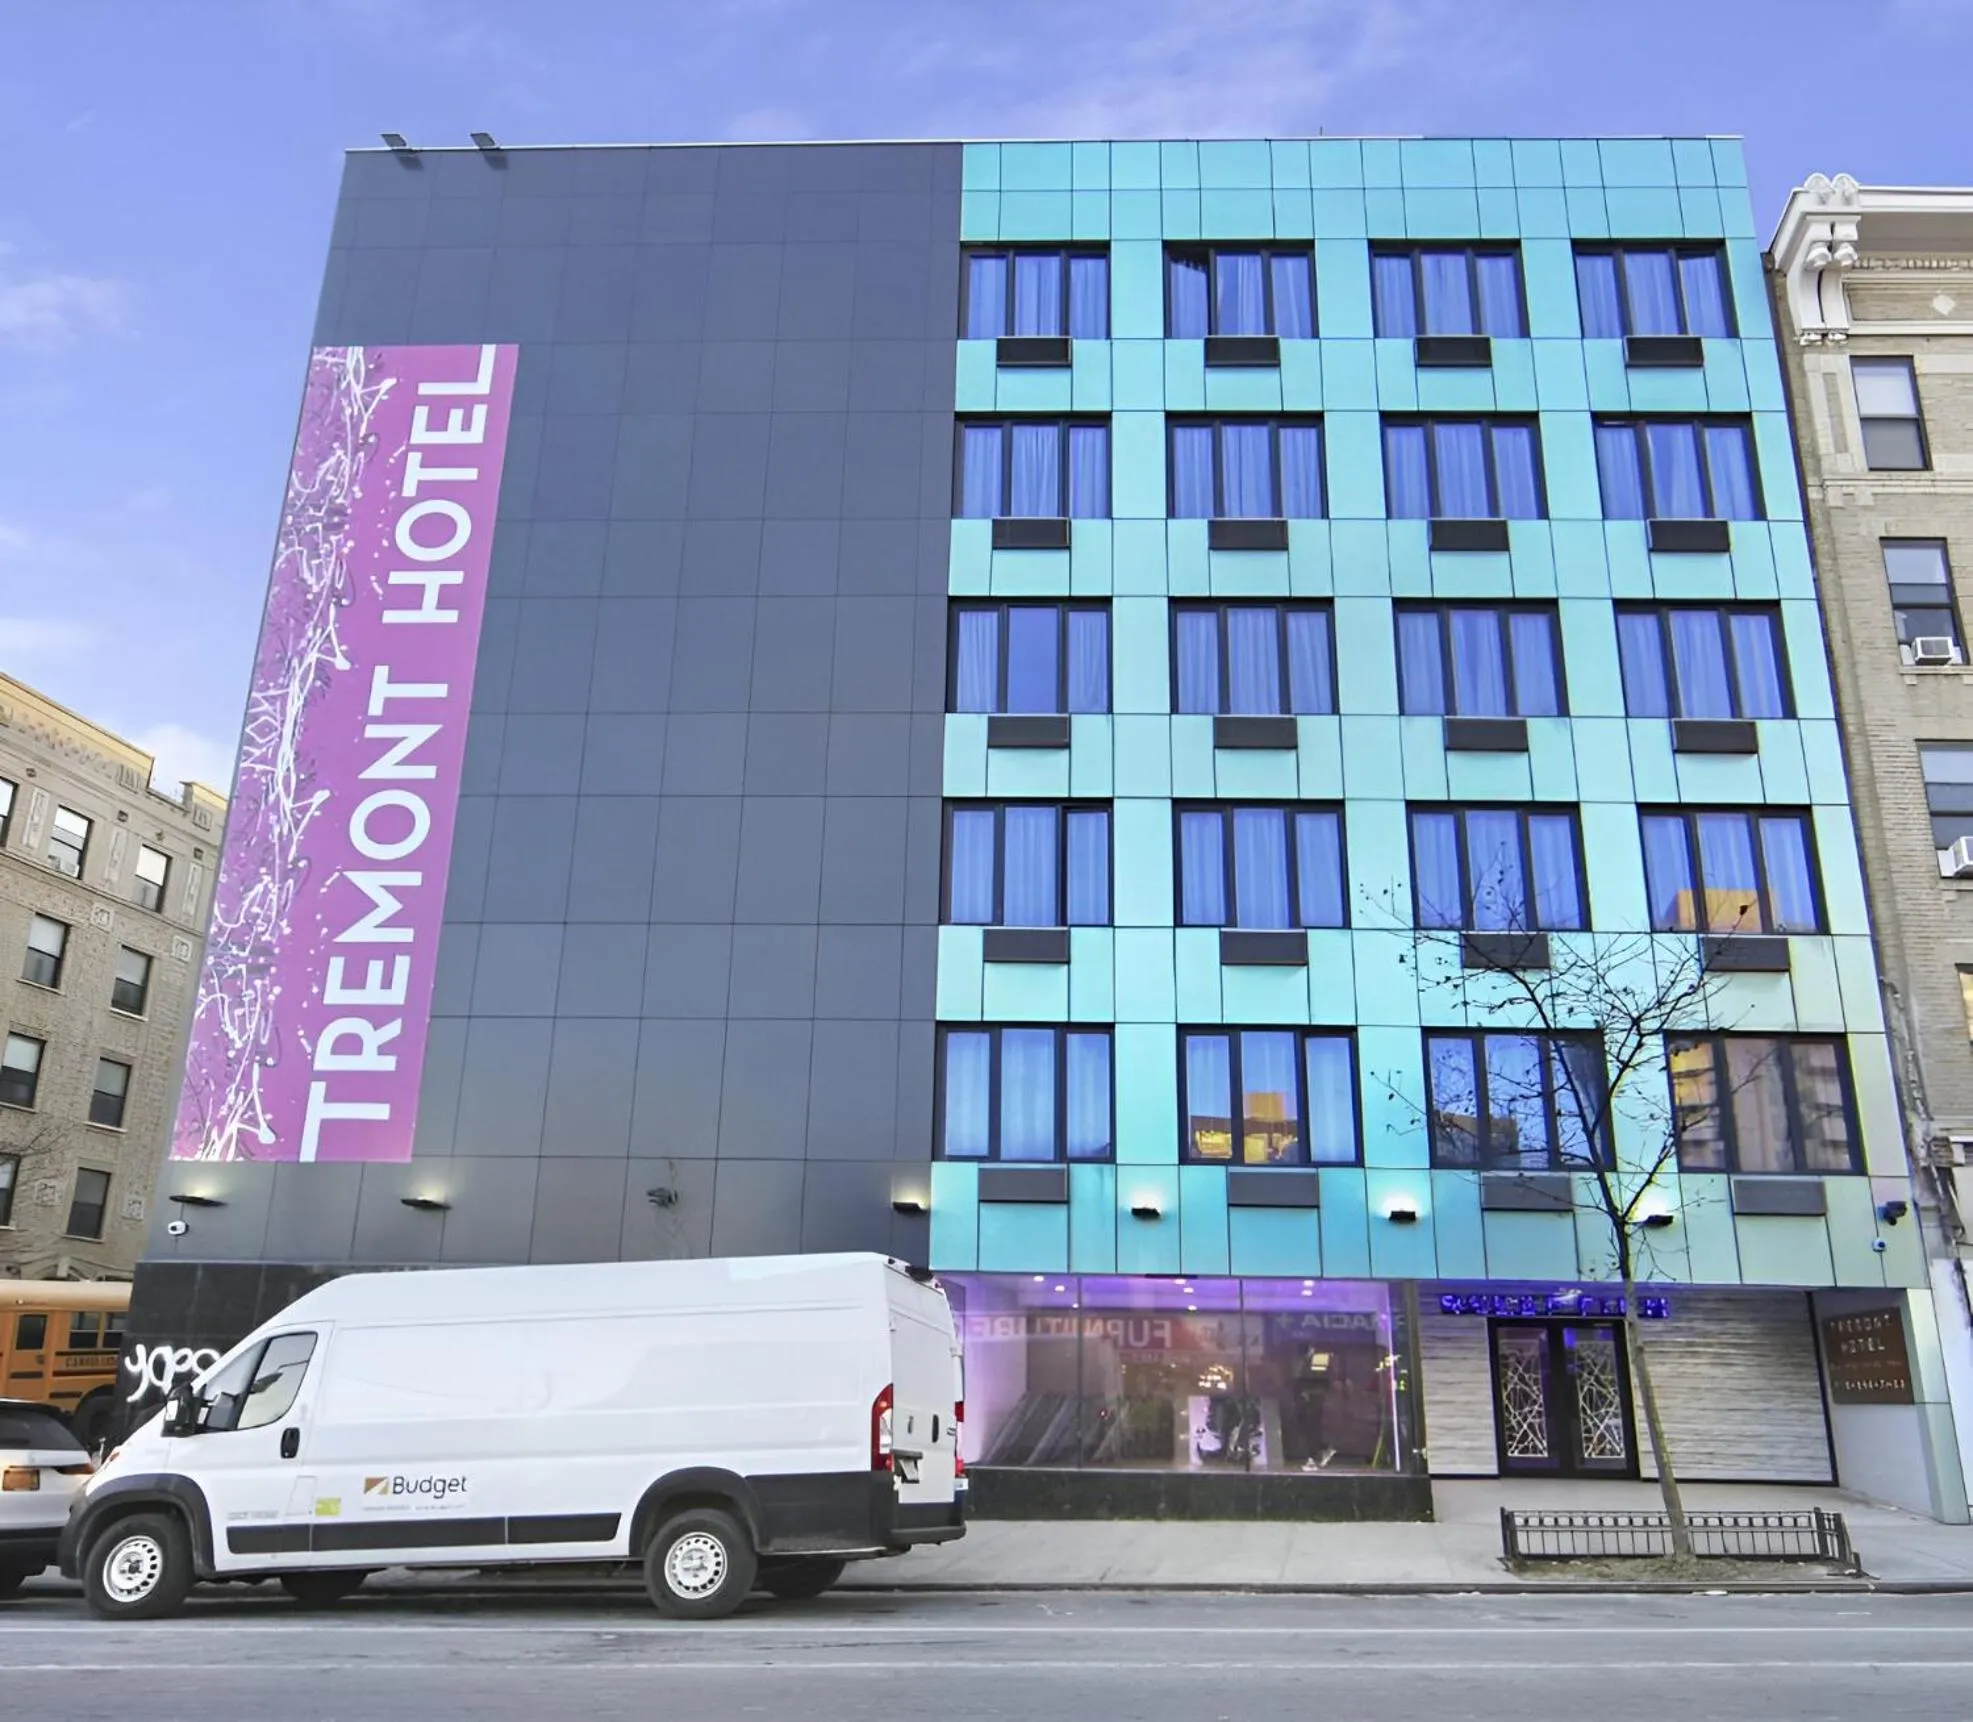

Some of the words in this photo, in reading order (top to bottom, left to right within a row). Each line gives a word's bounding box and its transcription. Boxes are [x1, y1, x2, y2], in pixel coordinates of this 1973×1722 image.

[298, 666, 449, 1163] TREMONT
[381, 343, 497, 624] HOTEL
[392, 1474, 468, 1500] Budget
